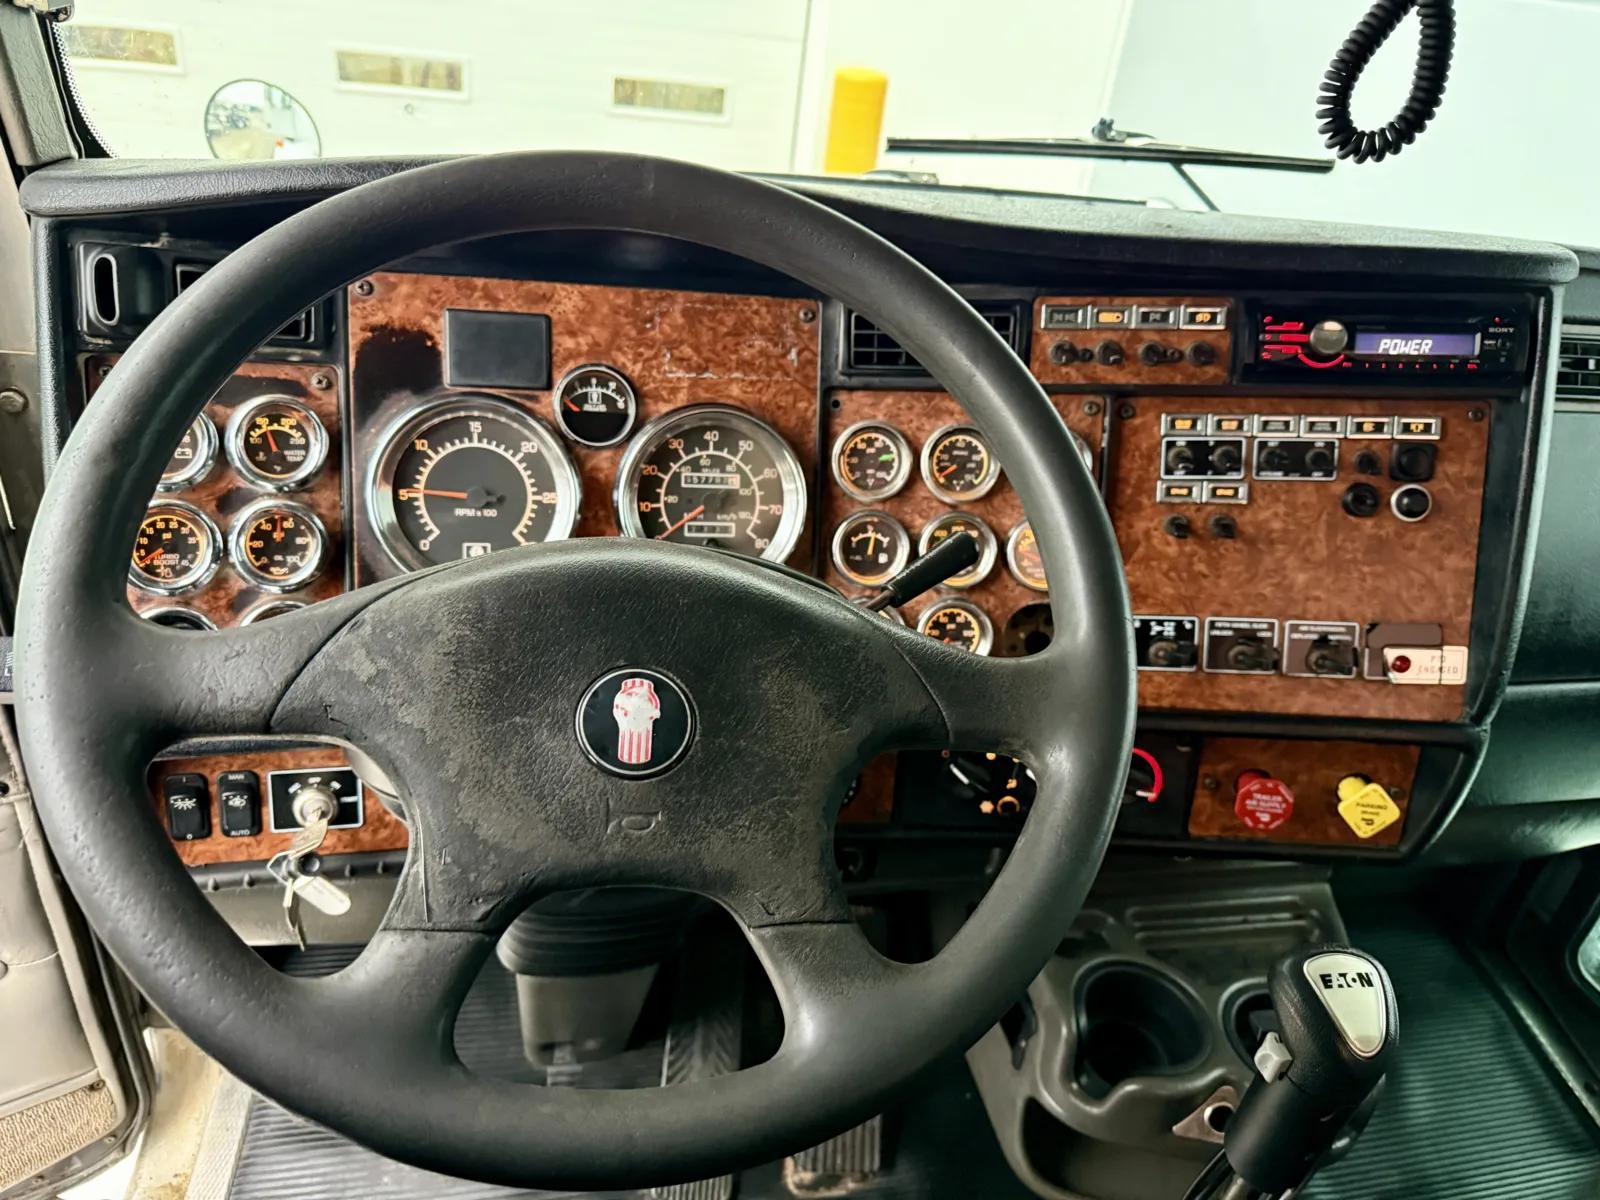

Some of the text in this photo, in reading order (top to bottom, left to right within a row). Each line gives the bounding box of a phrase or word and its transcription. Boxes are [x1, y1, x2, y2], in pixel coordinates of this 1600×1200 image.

[1378, 338, 1433, 356] POWER
[469, 421, 482, 433] 15
[703, 430, 719, 442] 40
[414, 439, 428, 450] 10
[520, 441, 538, 454] 20
[668, 438, 684, 449] 30
[738, 440, 753, 451] 50
[641, 465, 657, 475] 20
[763, 467, 778, 478] 60
[399, 489, 409, 500] 5
[739, 487, 752, 496] 100
[542, 492, 559, 504] 25
[640, 501, 652, 512] 10
[769, 504, 783, 515] 70
[455, 508, 476, 517] RPM
[482, 508, 498, 517] 100
[156, 521, 166, 529] 20
[169, 521, 179, 529] 25
[260, 523, 272, 531] 40
[282, 520, 295, 529] 60
[146, 527, 155, 535] 15
[140, 537, 149, 545] 10
[252, 540, 264, 548] 20
[420, 540, 430, 551] 0
[755, 538, 769, 549] 80
[228, 773, 245, 781] MAN
[1319, 972, 1374, 989] EATON
